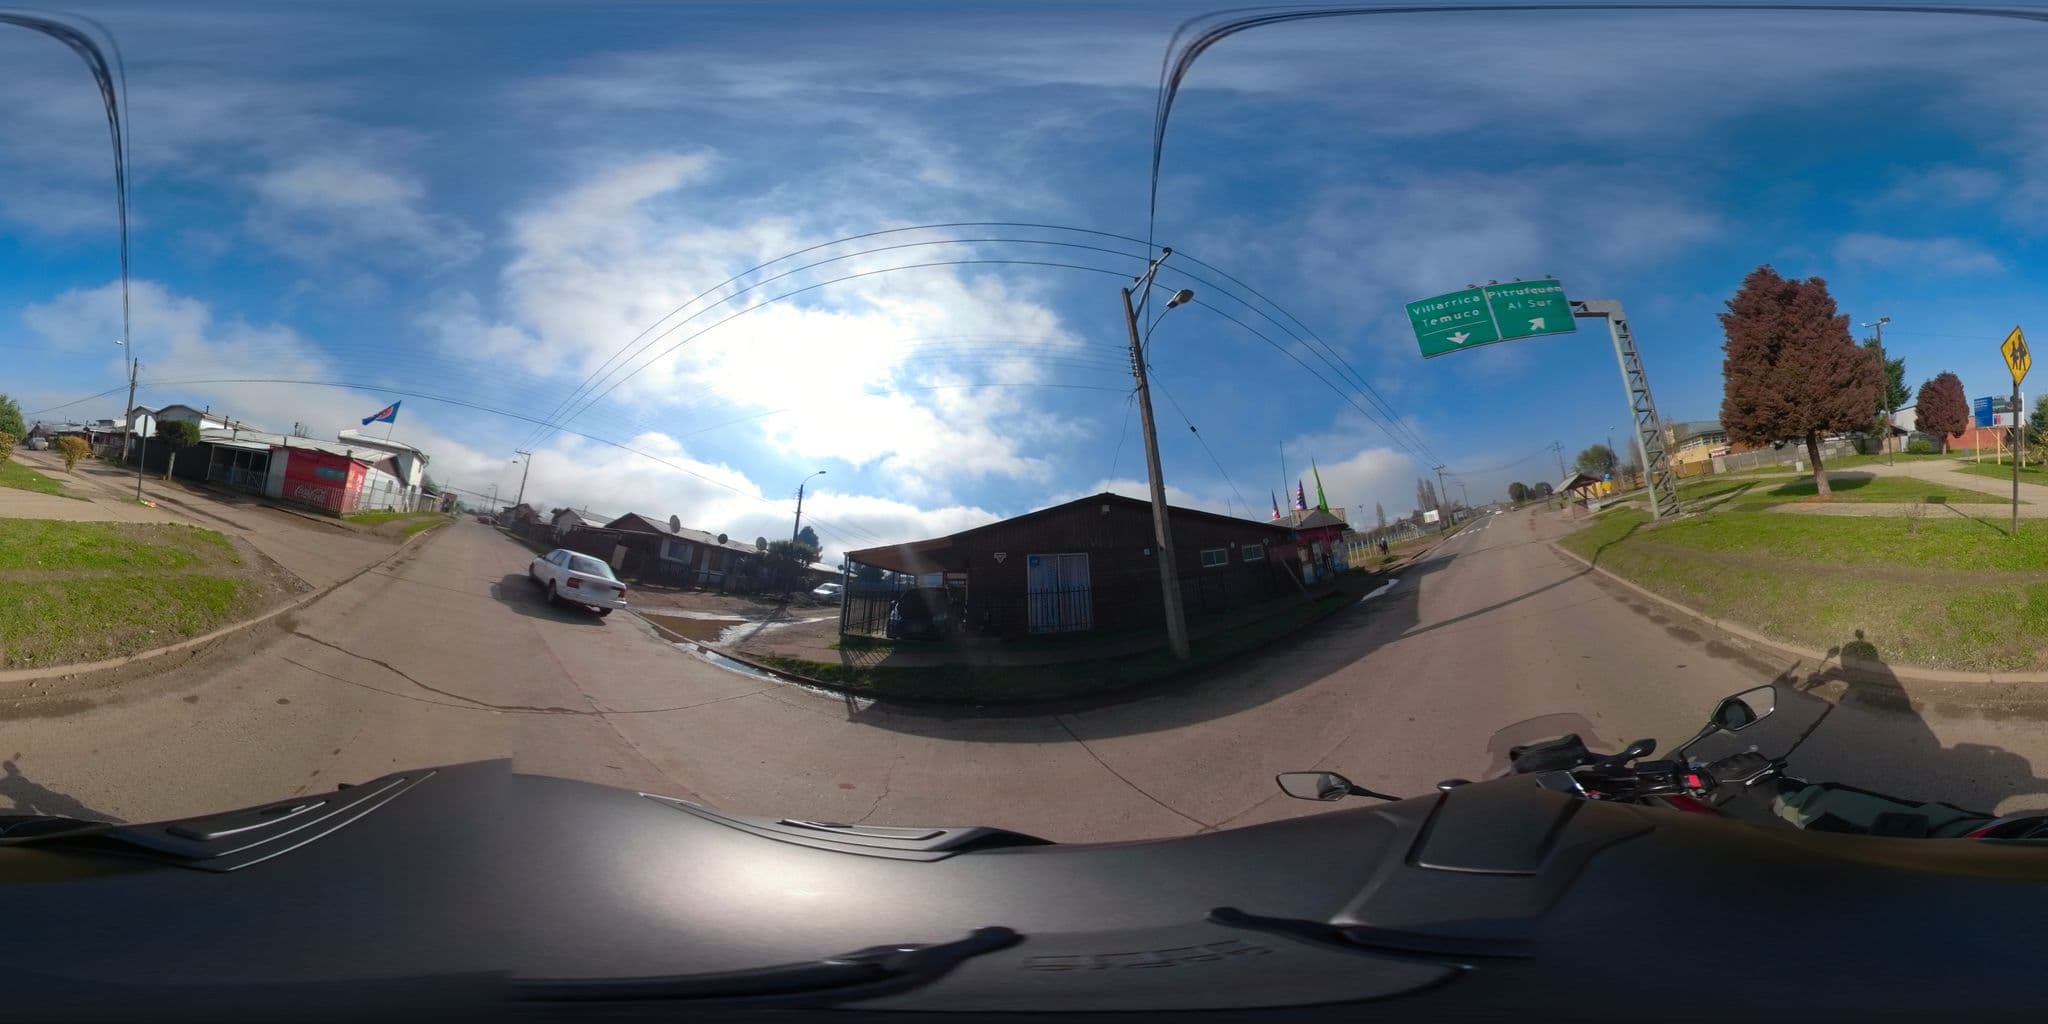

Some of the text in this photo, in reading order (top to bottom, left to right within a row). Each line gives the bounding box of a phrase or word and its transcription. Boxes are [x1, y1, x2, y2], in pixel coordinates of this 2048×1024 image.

[1412, 296, 1481, 315] Villarrica
[1508, 299, 1553, 310] Al Sur
[1421, 309, 1480, 327] Temuco
